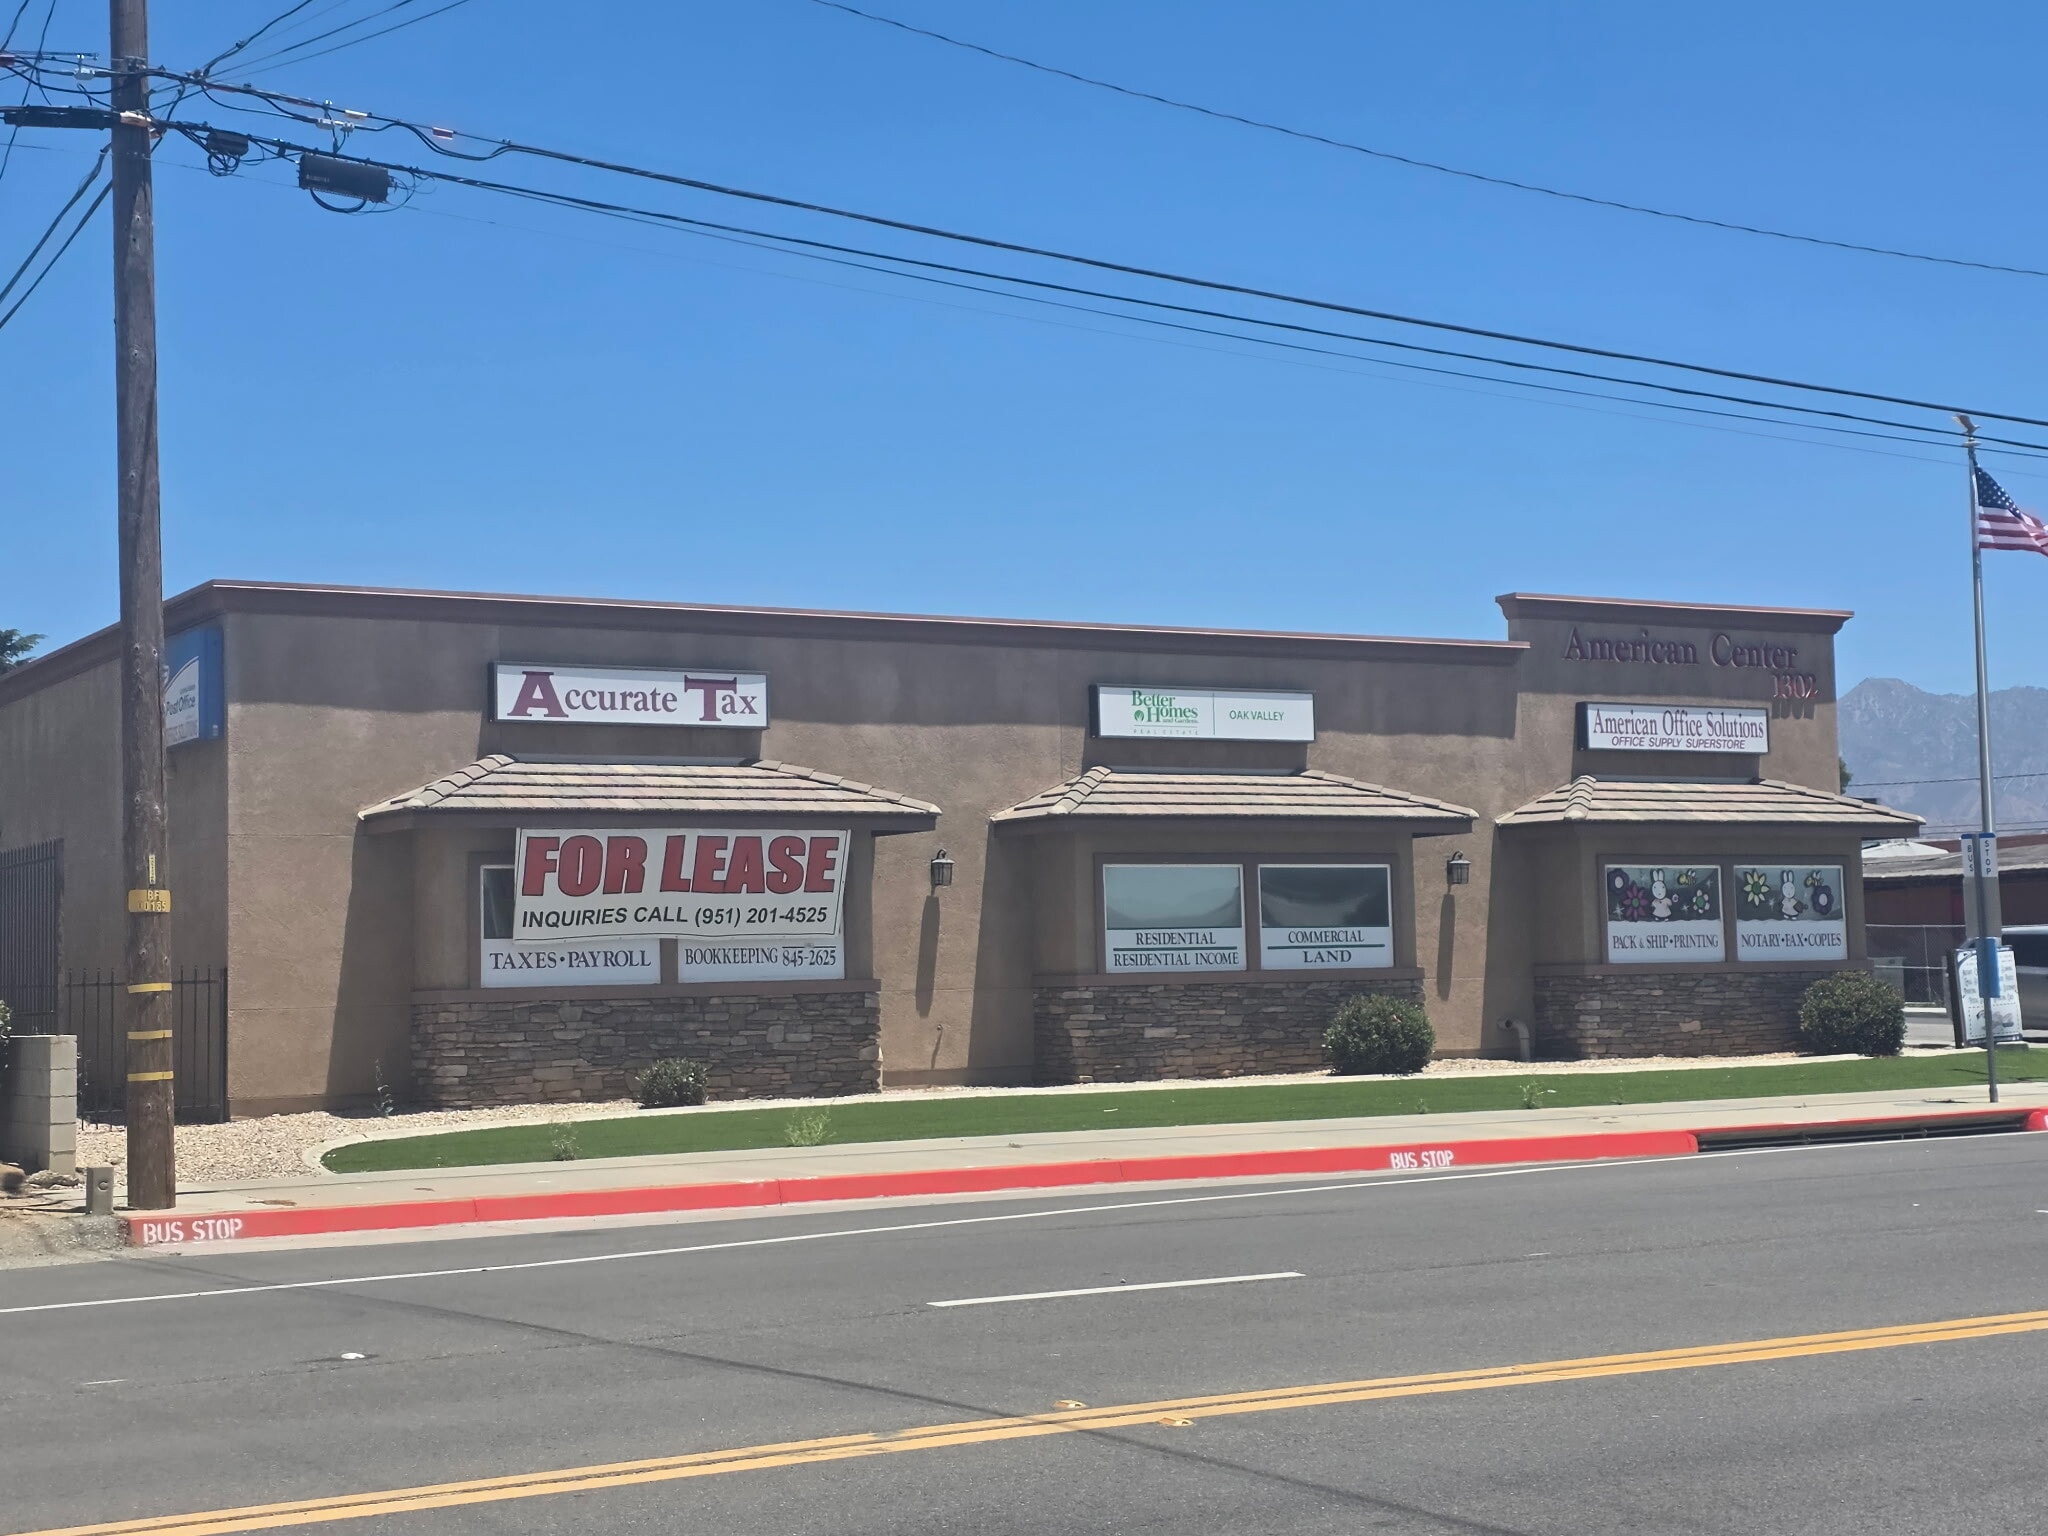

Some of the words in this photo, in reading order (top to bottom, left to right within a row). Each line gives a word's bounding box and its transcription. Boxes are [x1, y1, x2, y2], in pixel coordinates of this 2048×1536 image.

[1562, 625, 1700, 665] American
[1710, 631, 1799, 669] Center
[1771, 672, 1818, 699] 1302
[507, 671, 677, 718] Accurate
[684, 674, 758, 721] Tax
[1132, 690, 1176, 707] Better
[1147, 706, 1198, 723] Homes
[1229, 710, 1249, 720] OAK
[1250, 711, 1284, 721] VALLEY
[1593, 708, 1657, 735] American
[1662, 709, 1702, 737] Office
[1706, 711, 1764, 739] Solutions
[1611, 736, 1644, 746] OFFICE
[1648, 737, 1682, 748] SUPPLY
[1686, 738, 1745, 749] SUPERSTORE
[521, 834, 648, 897] FOR
[660, 835, 840, 895] LEASE
[1984, 839, 1992, 875] STOP
[521, 908, 627, 928] INQUIRIES
[633, 906, 688, 923] CALL
[695, 906, 741, 928] (951)
[746, 906, 827, 923] 201-4525
[1135, 931, 1216, 945] RESIDENTIAL
[1288, 930, 1364, 944] COMMERCIAL
[1613, 935, 1636, 949] PACK
[685, 948, 778, 965] BOOKKEEPING
[782, 949, 836, 967] 845-2625
[1114, 952, 1191, 967] RESIDENTIAL
[1195, 951, 1239, 966] INCOME
[1303, 950, 1352, 964] LAND
[1390, 1152, 1418, 1169] BUS
[1421, 1150, 1454, 1168] STOP
[143, 1221, 184, 1244] BUS
[191, 1218, 243, 1240] STOP
